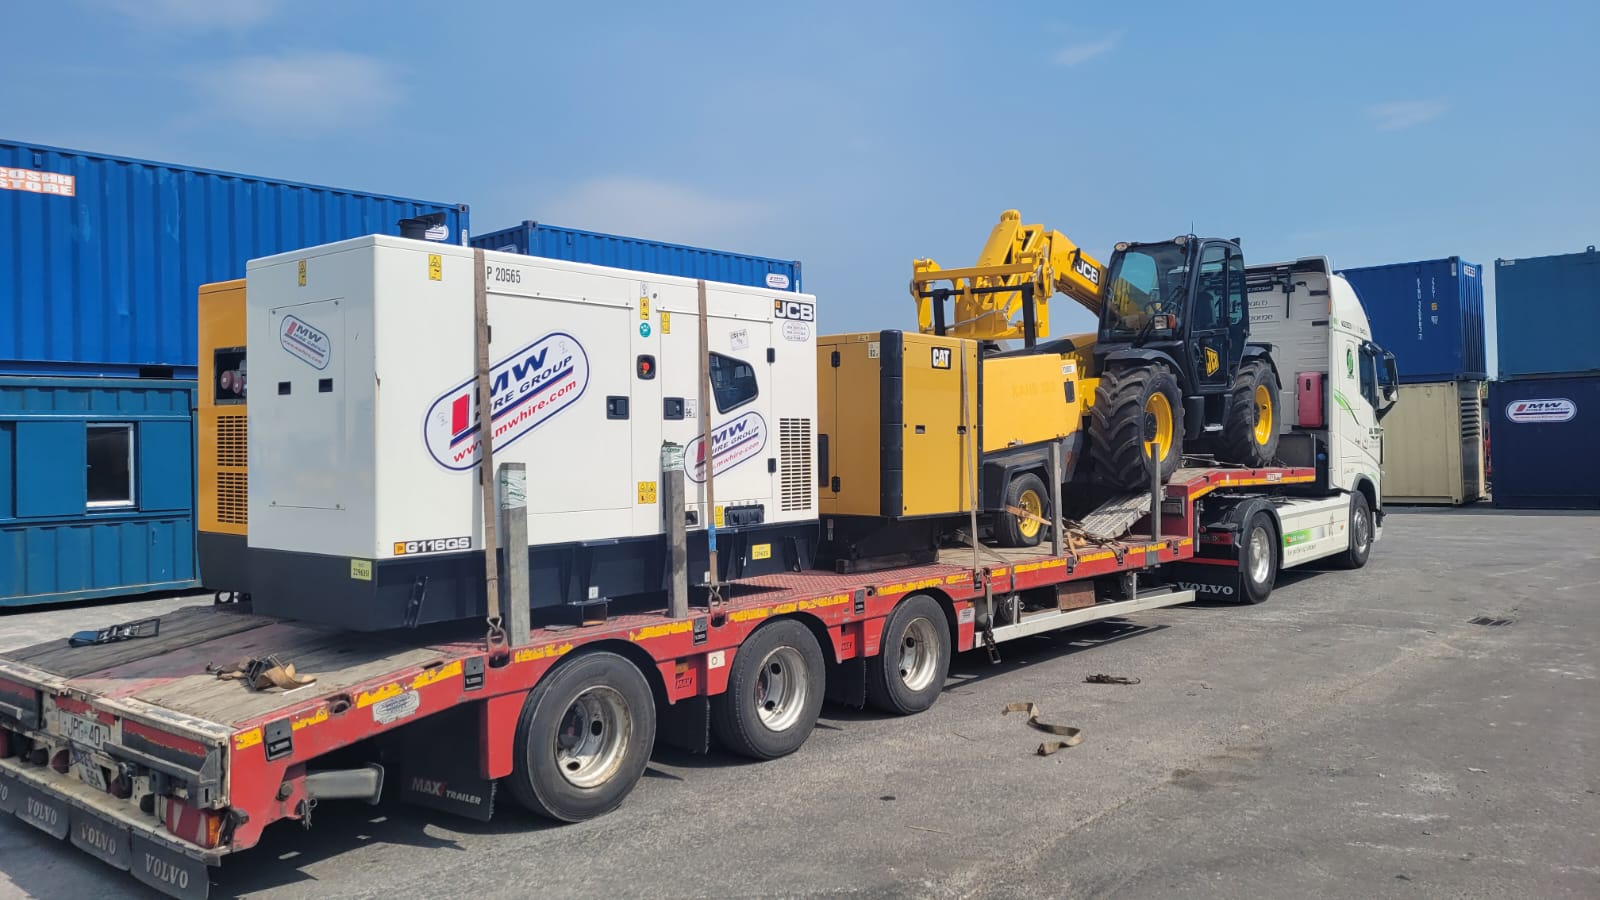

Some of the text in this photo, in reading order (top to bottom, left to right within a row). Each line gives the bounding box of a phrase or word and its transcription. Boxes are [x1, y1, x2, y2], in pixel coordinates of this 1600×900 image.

[496, 267, 520, 283] 20565
[1076, 260, 1099, 285] JCB
[775, 301, 813, 321] JCB
[296, 325, 322, 343] MW
[932, 348, 950, 368] CAT
[520, 355, 573, 394] GROUP
[711, 419, 748, 446] MW
[1177, 582, 1234, 595] VOLVO
[446, 789, 482, 805] TRAILER
[27, 797, 57, 825] VOLVO
[81, 822, 116, 856] VOLVO
[145, 853, 188, 888] VOLVO
